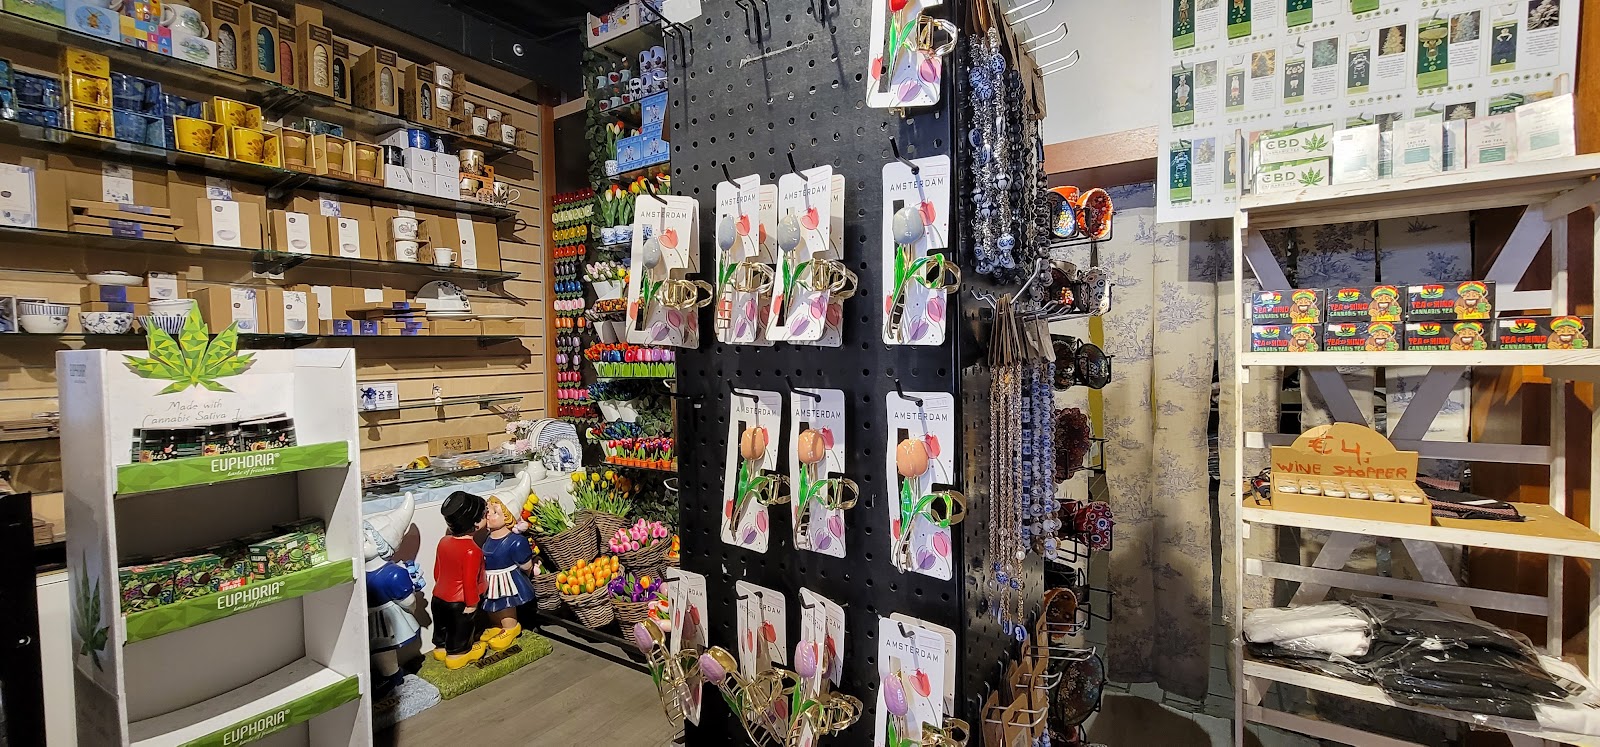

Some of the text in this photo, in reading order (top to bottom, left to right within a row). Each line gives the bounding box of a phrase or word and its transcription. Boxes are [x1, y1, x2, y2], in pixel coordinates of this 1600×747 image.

[1266, 138, 1299, 150] CBD
[1262, 171, 1296, 183] CBD
[890, 177, 944, 192] AMSTERDAM
[784, 185, 827, 201] AMSTERDAM
[721, 194, 756, 207] AMSTERDAM
[641, 211, 687, 219] AMSTERDAM
[1330, 303, 1343, 311] TEA
[1350, 302, 1368, 310] MIND
[1411, 301, 1426, 309] TEA
[1433, 300, 1454, 308] MIND
[1327, 338, 1340, 346] TEA
[1347, 338, 1365, 346] MIND
[1430, 337, 1450, 345] MIND
[1500, 336, 1516, 344] TEA
[1526, 335, 1547, 343] MIND
[167, 399, 222, 412] Made with
[736, 406, 777, 416] AMSTERDAM
[142, 412, 191, 427] Cannabis
[195, 410, 226, 421] Sativa
[795, 408, 841, 419] AMSTERDAM
[894, 411, 948, 421] AMSTERDAM
[1276, 460, 1321, 475] WINE
[886, 639, 939, 663] AMSTERDAM
